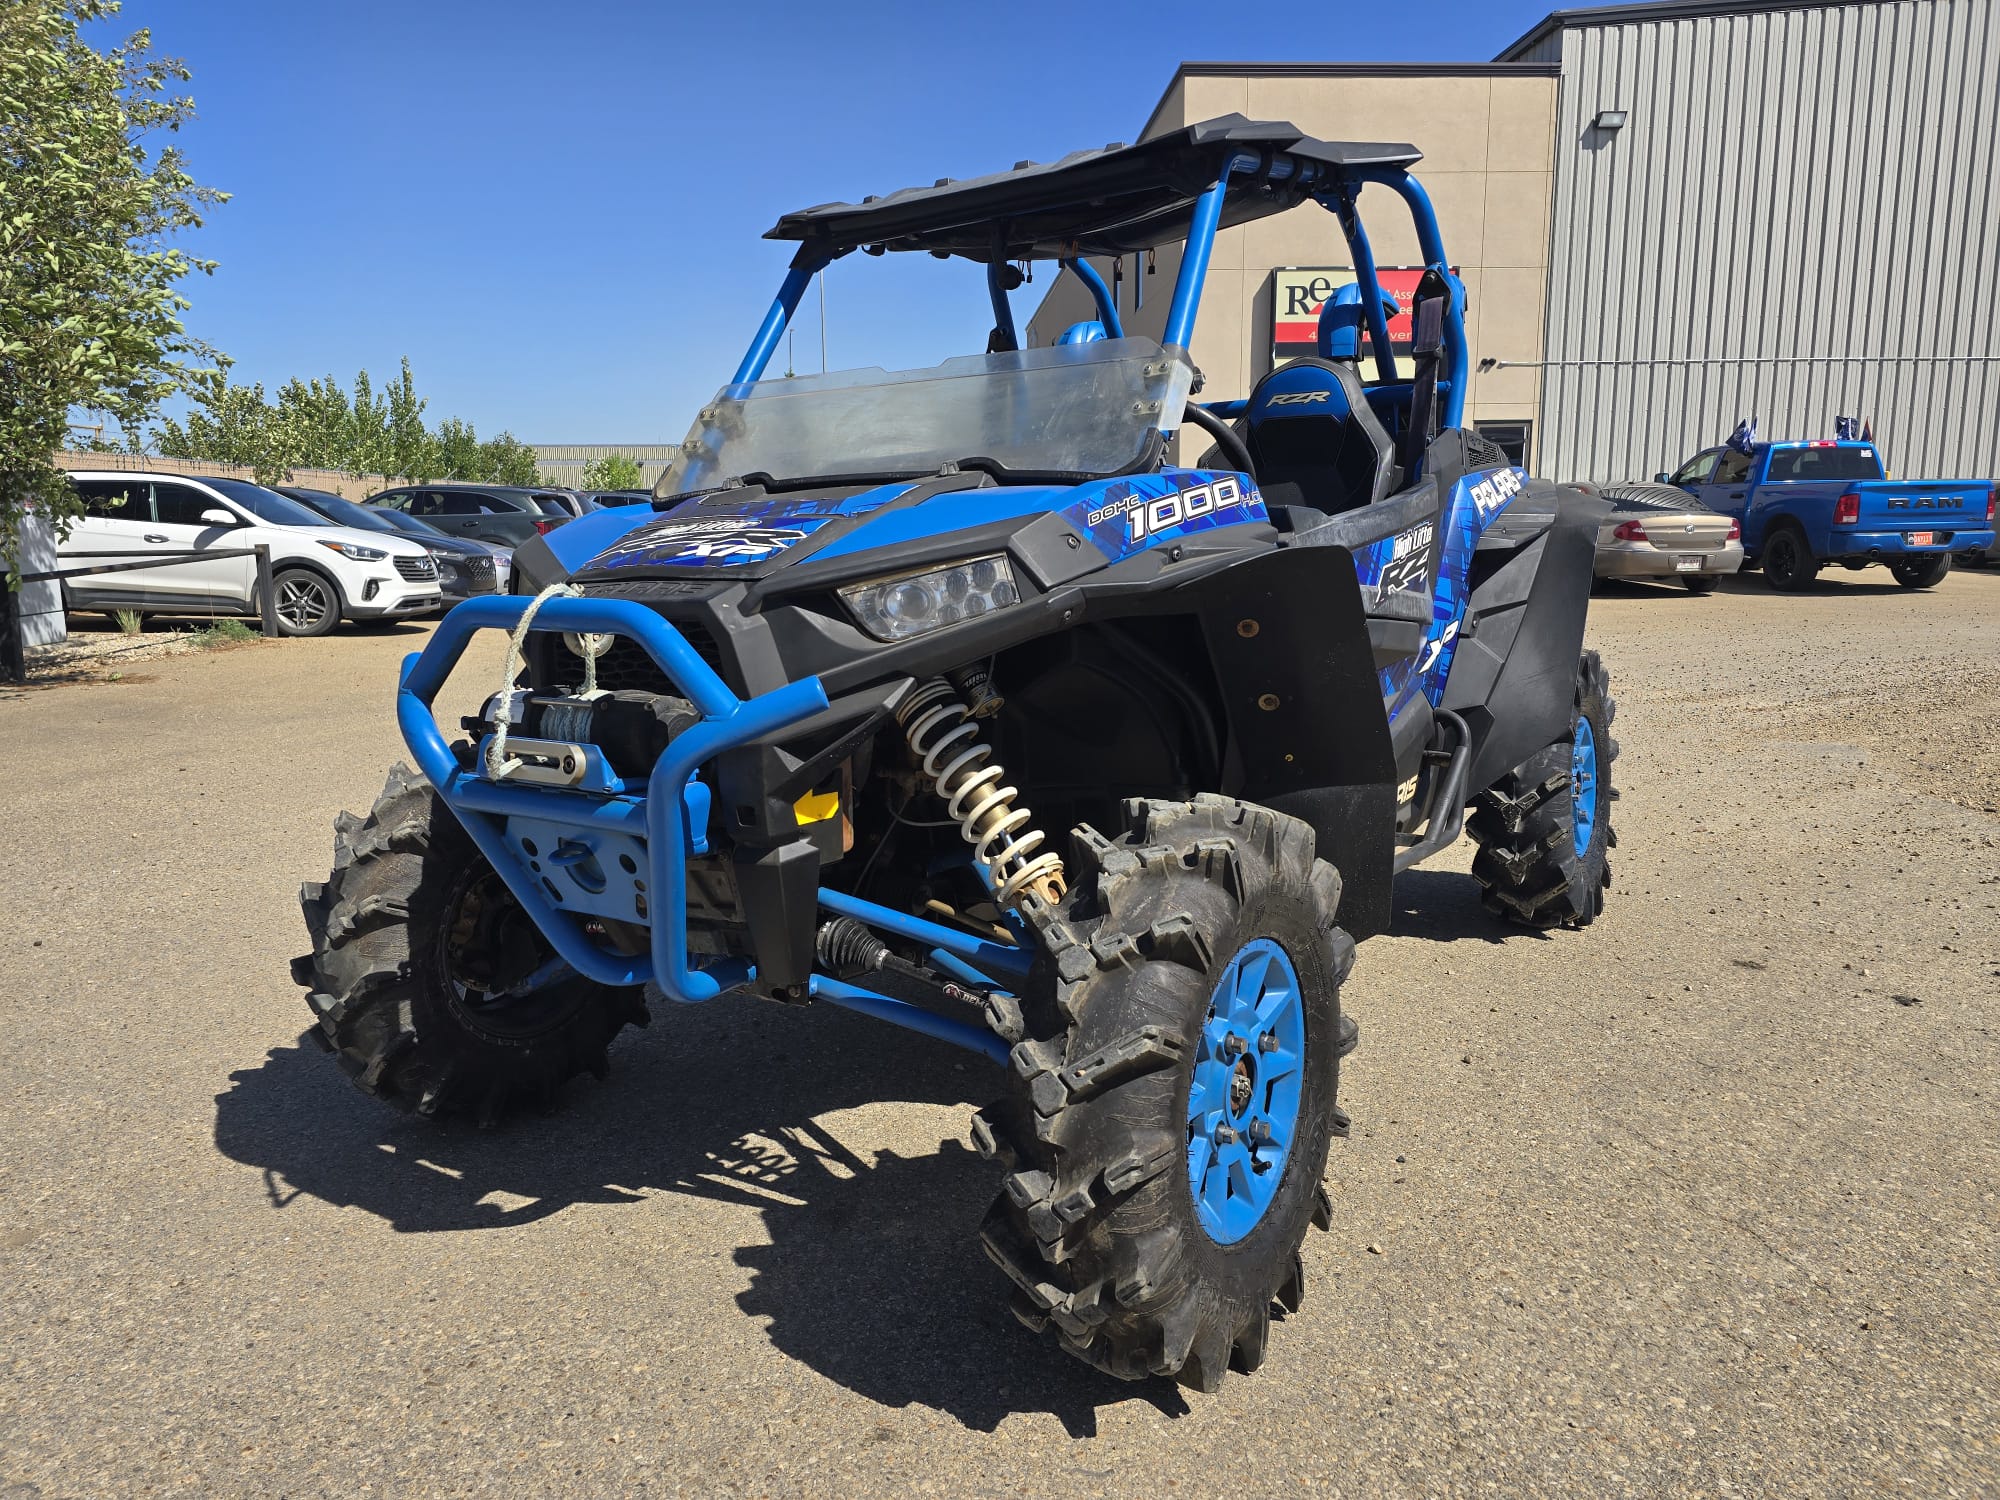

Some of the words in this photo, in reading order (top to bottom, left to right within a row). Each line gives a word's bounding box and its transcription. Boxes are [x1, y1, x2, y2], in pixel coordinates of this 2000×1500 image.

[1285, 277, 1338, 315] Re
[1266, 391, 1331, 408] RZR
[1088, 494, 1141, 527] DOHC
[1127, 476, 1241, 544] 1000
[1888, 496, 1964, 509] RAM
[1418, 619, 1459, 674] XP
[1396, 774, 1418, 805] RIS
